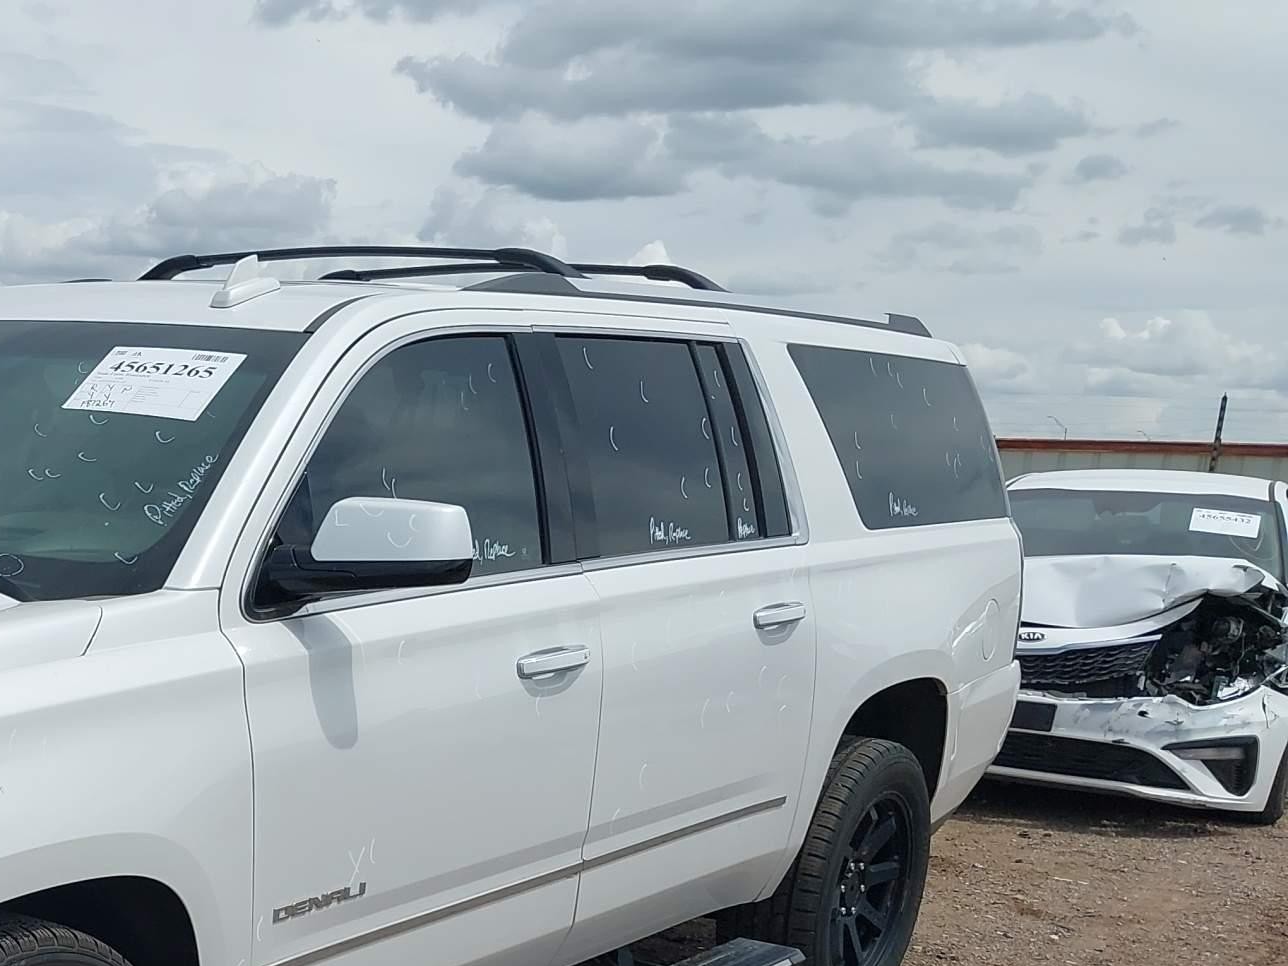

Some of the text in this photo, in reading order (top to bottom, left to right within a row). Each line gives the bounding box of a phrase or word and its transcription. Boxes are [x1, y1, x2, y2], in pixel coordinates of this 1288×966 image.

[109, 360, 218, 379] 45651265
[1020, 632, 1043, 641] KIA
[272, 881, 367, 924] DENALI
